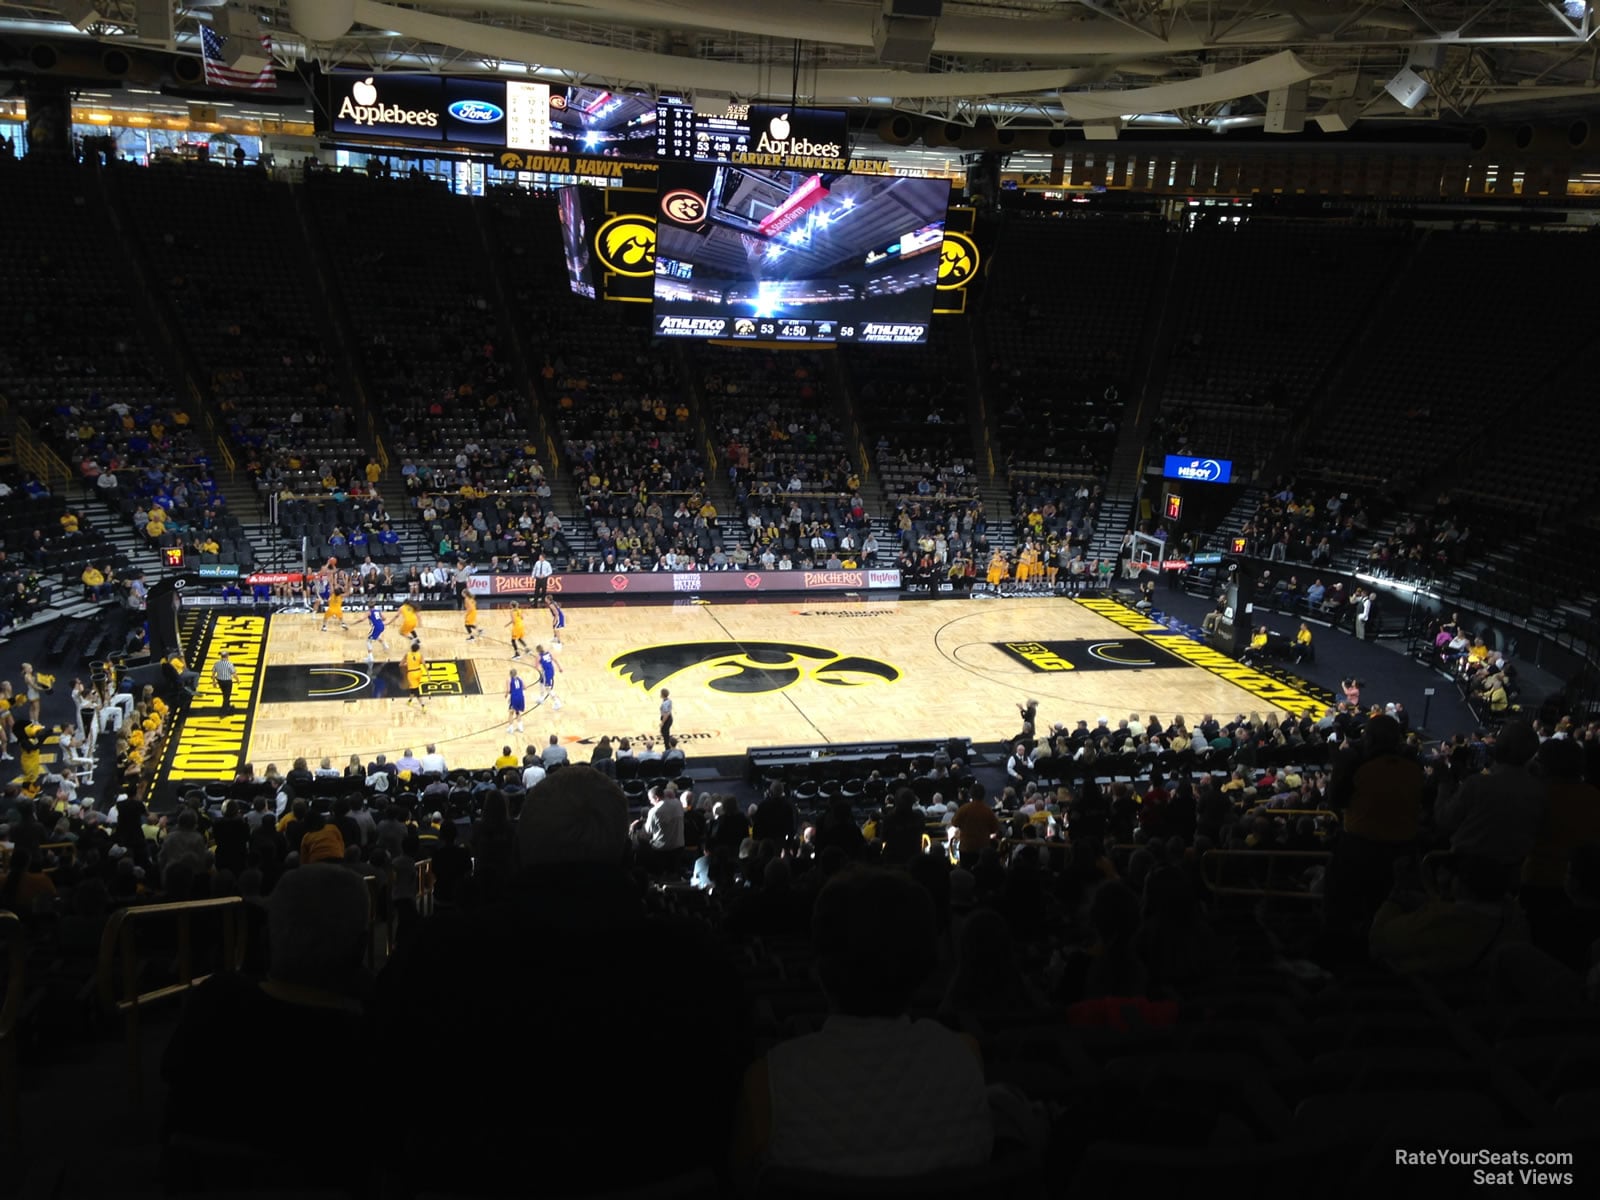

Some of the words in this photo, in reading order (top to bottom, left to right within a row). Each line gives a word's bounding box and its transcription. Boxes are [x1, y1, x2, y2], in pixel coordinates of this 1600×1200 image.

[338, 96, 438, 126] Applebee's
[459, 104, 493, 119] Ford
[697, 142, 709, 151] 53
[525, 155, 570, 173] IOWA
[847, 158, 890, 172] ARENA
[659, 316, 725, 330] ATHLETICO
[760, 324, 775, 334] 53
[862, 323, 924, 336] ATHLETICO
[781, 325, 807, 336] 4:50
[840, 327, 854, 336] 58
[496, 575, 562, 592] PANCHOS
[803, 571, 863, 588] PANCHEROS
[1073, 597, 1168, 632] IOWA
[168, 714, 247, 781] IOWA
